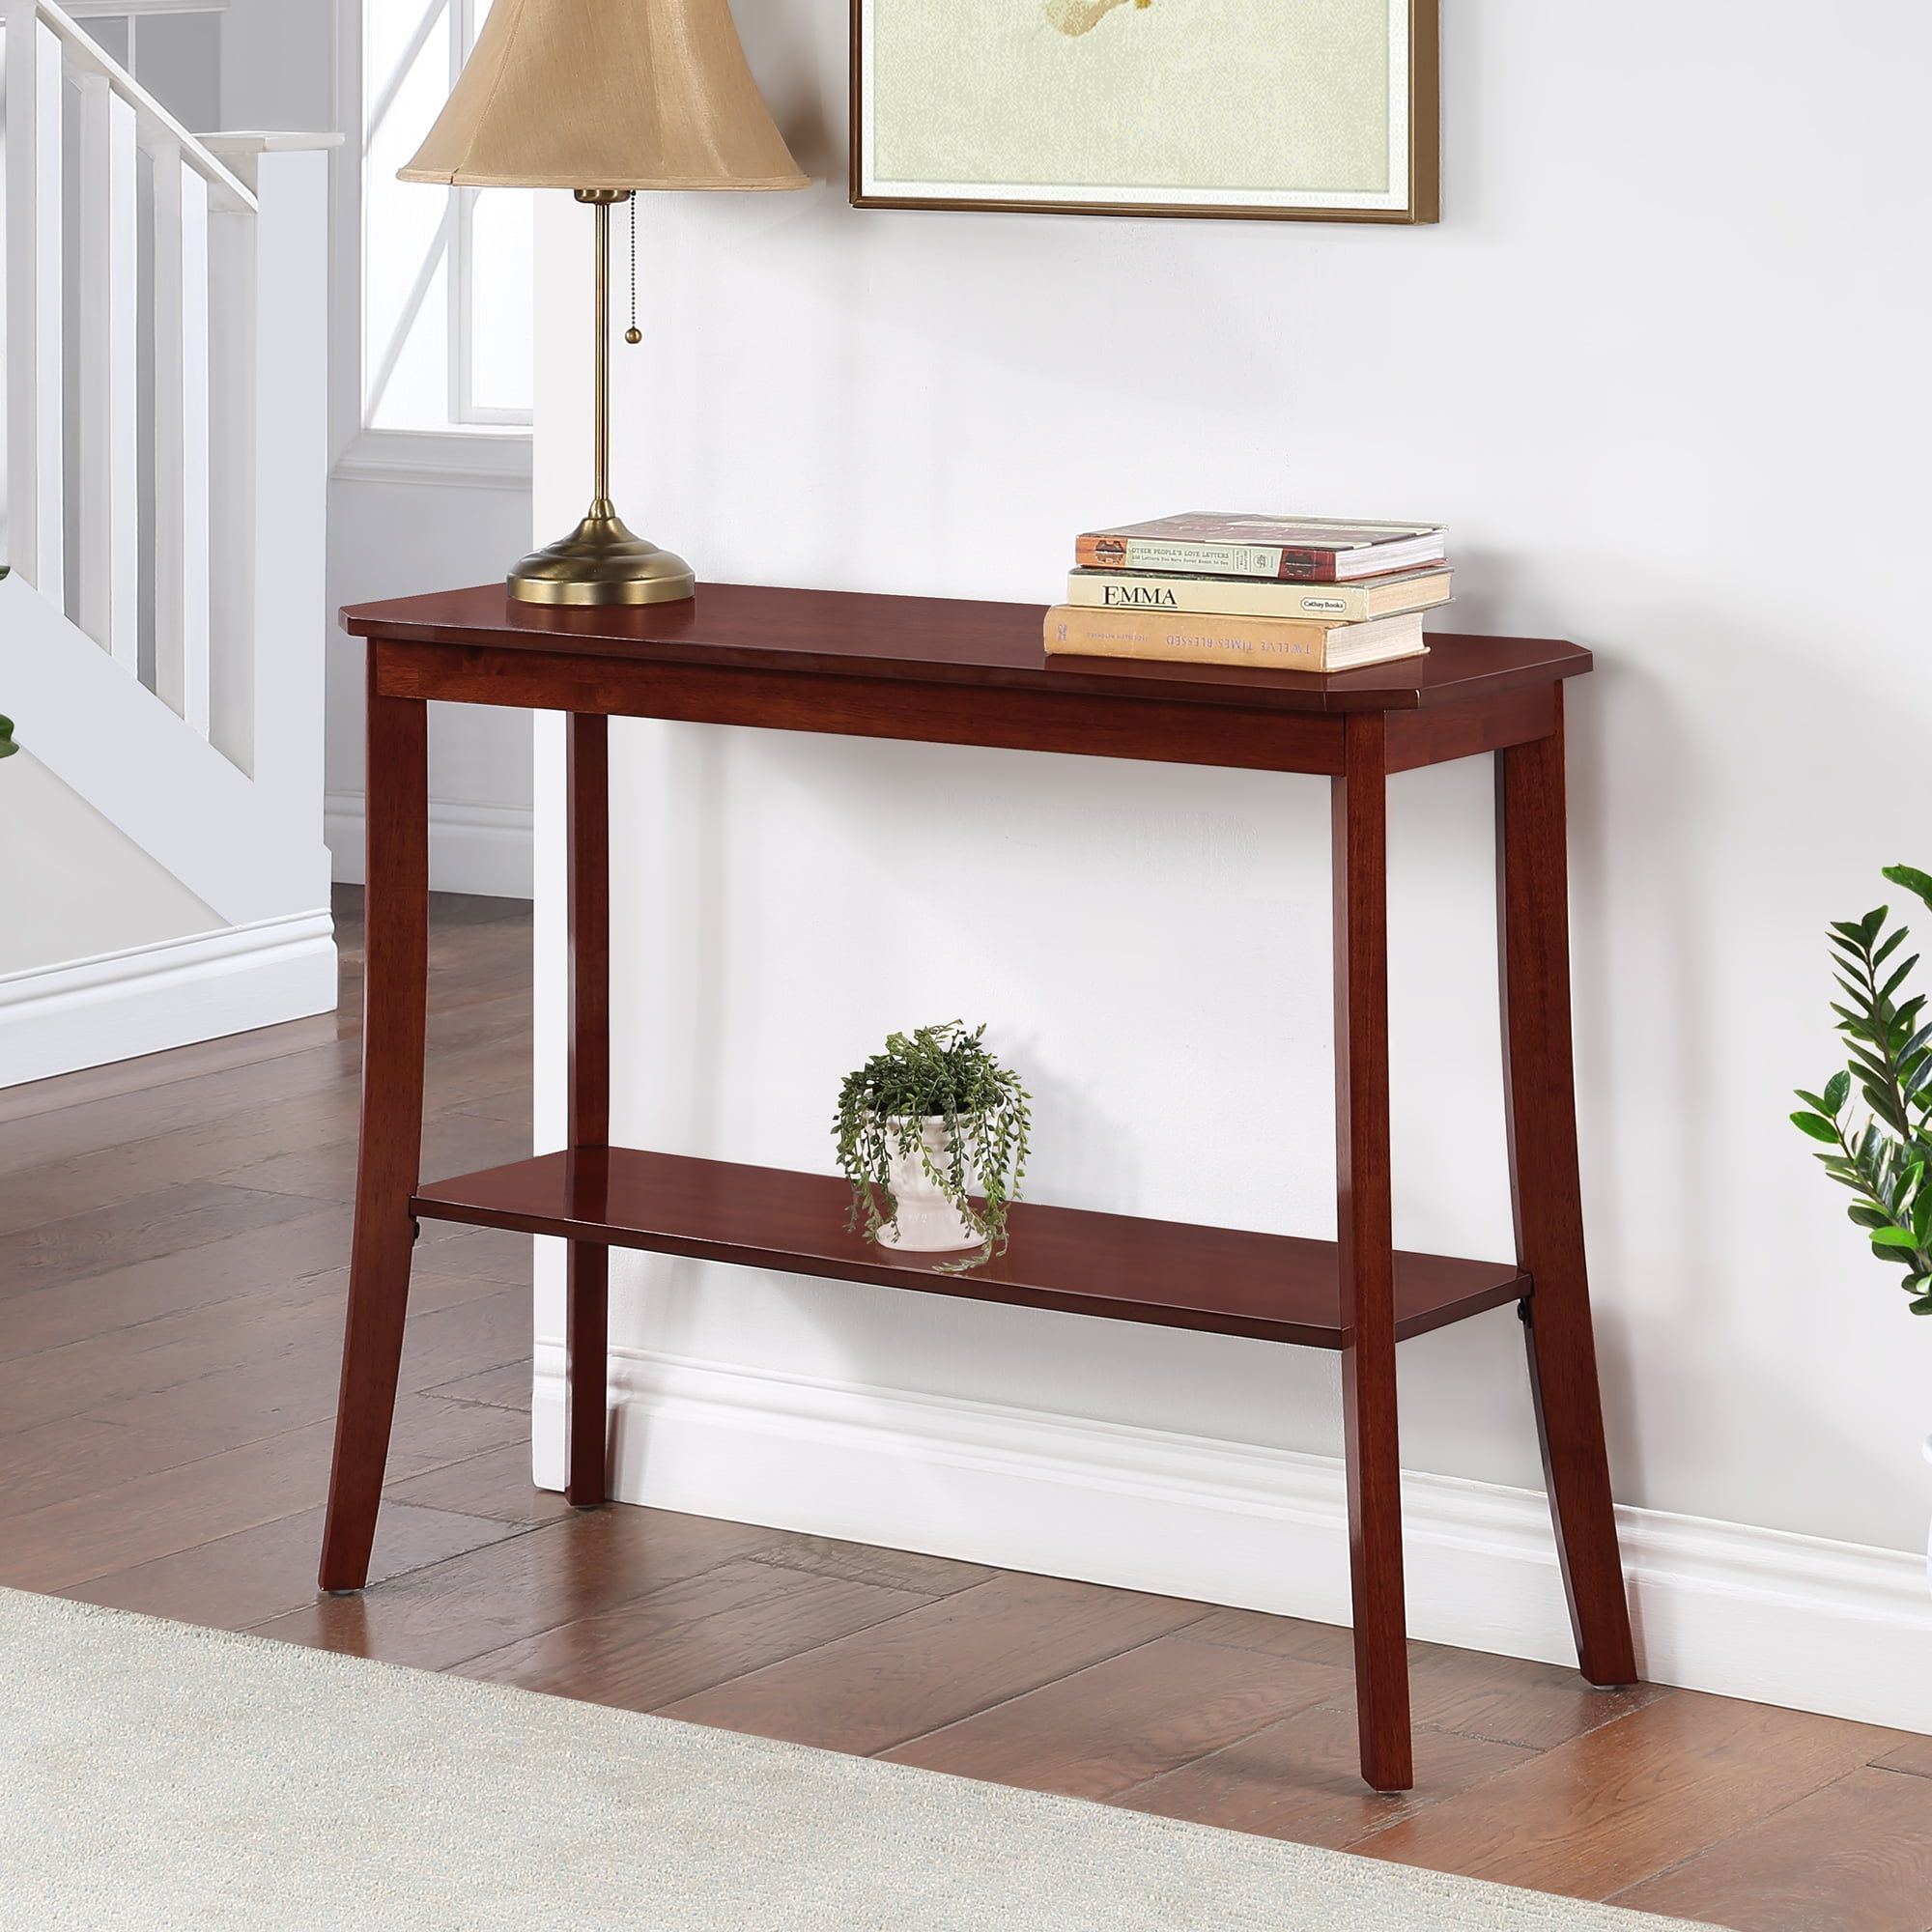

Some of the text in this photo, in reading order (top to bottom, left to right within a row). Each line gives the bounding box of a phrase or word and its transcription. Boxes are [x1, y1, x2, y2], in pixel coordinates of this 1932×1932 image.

[1102, 585, 1177, 607] EMMA
[1166, 636, 1213, 649] BLESSED
[1217, 639, 1253, 652] TIMES
[1261, 641, 1312, 655] TWELVE
